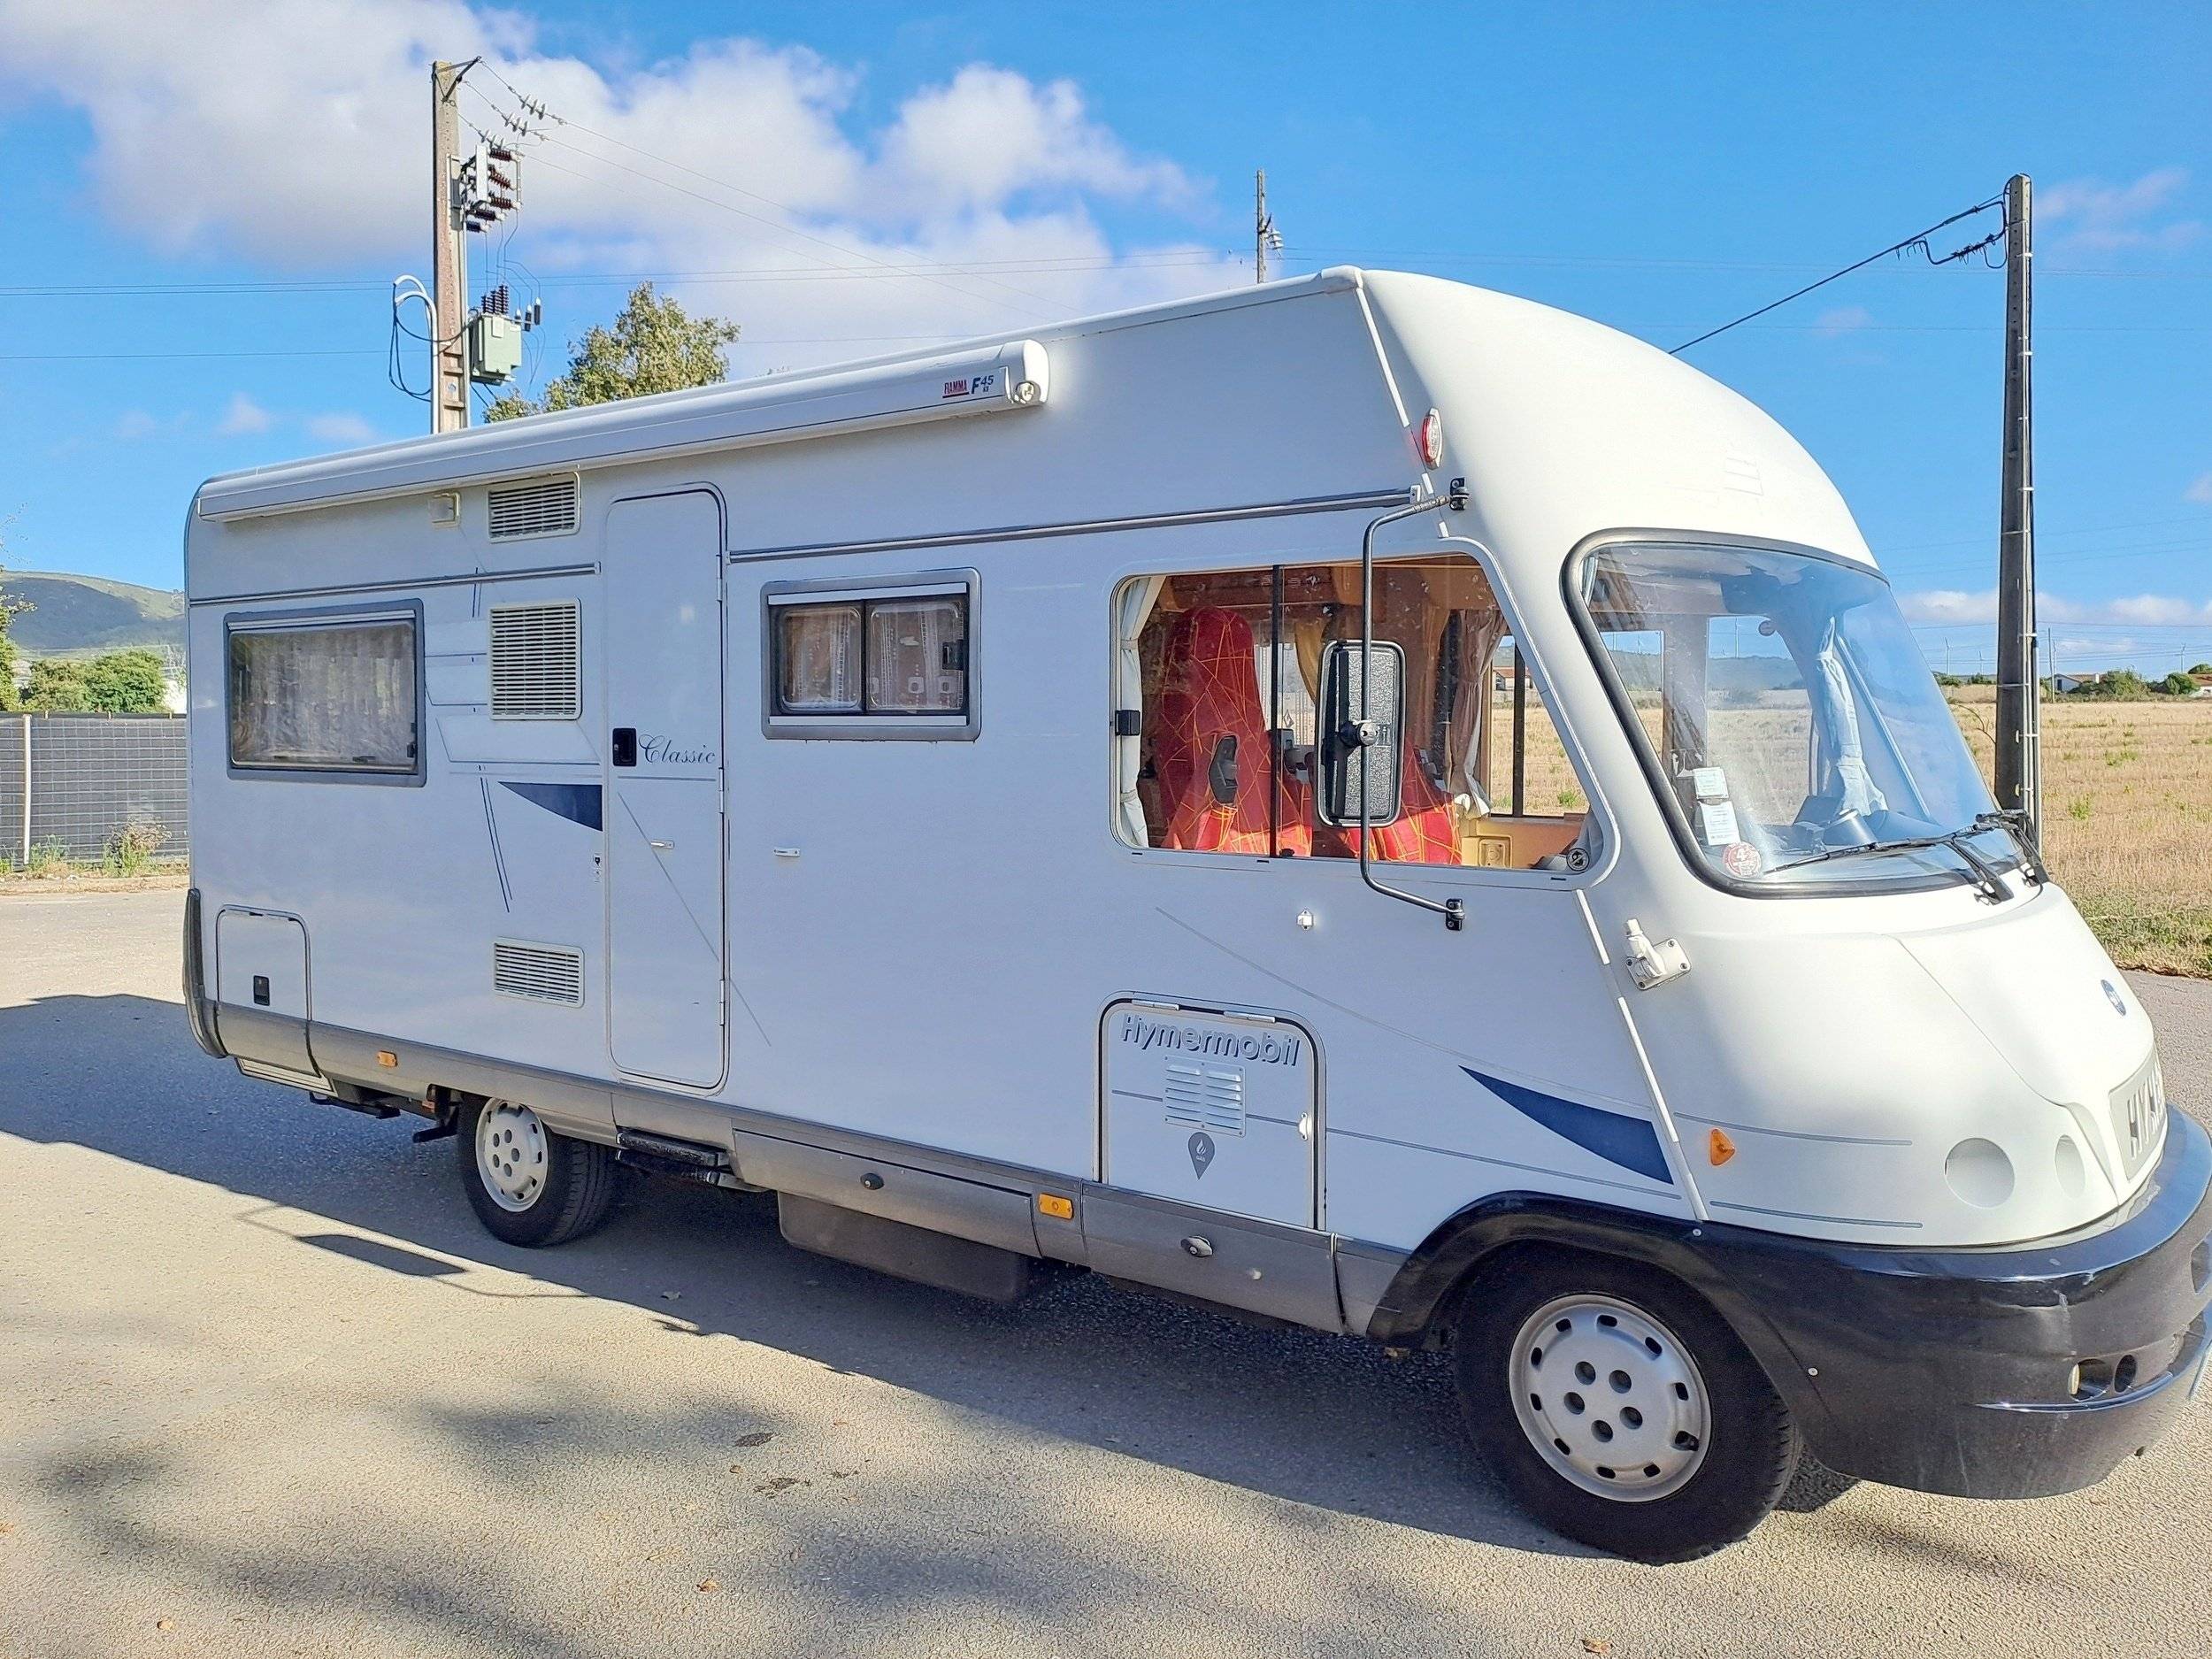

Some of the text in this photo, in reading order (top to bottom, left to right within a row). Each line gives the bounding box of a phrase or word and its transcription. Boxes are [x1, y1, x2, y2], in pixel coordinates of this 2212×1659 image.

[943, 375, 995, 395] FIAMMA F45
[638, 733, 716, 764] Classic
[1121, 1013, 1301, 1067] Hymermobil
